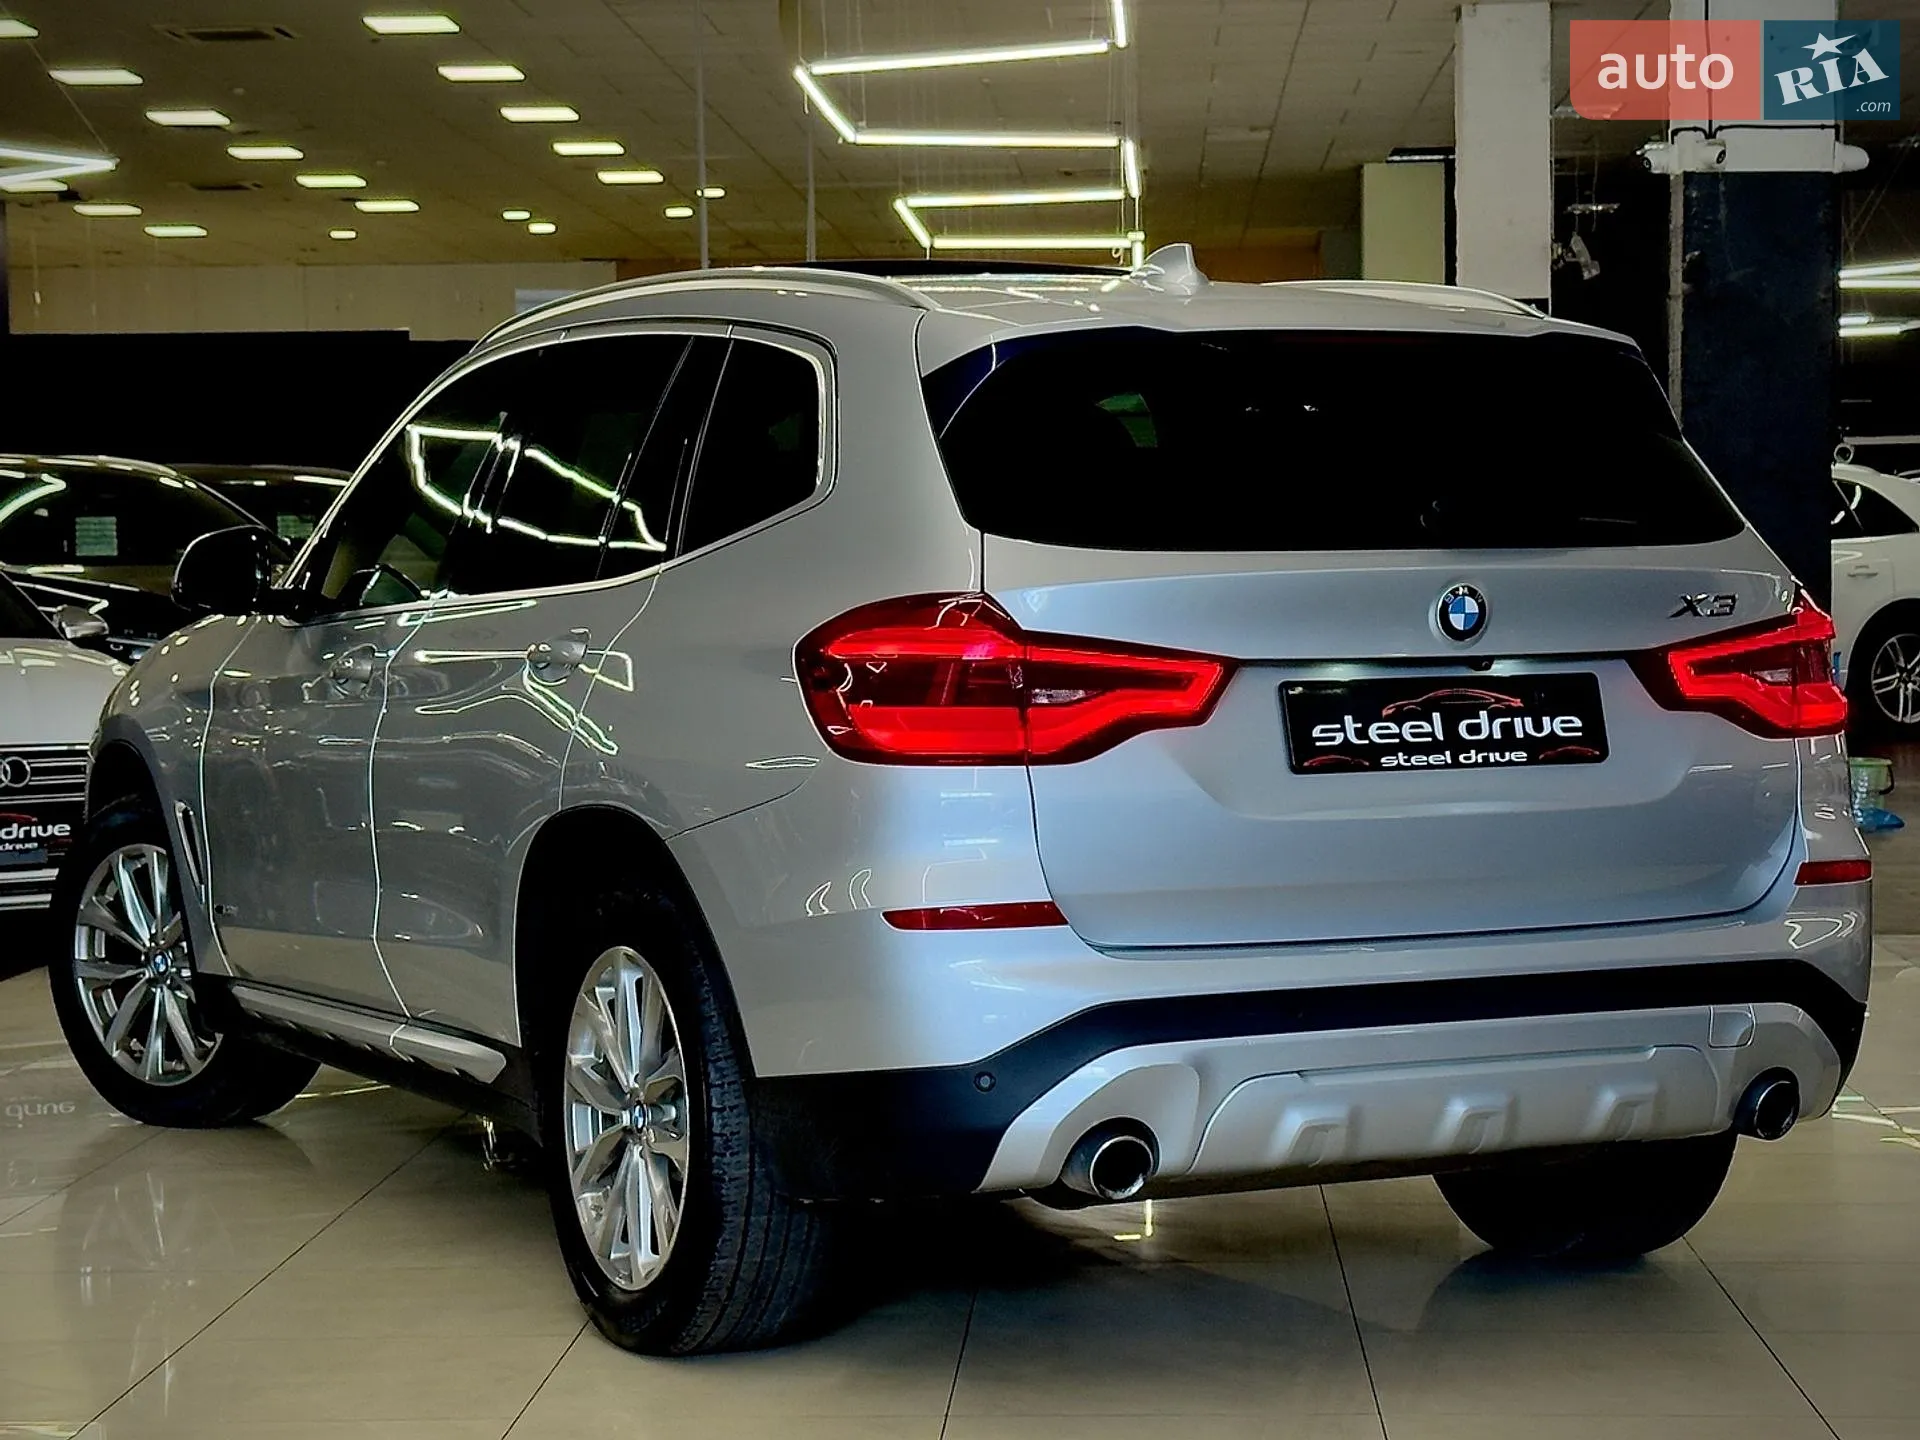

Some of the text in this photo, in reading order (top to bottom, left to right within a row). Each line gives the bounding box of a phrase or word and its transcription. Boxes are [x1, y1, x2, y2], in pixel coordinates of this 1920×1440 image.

[1668, 592, 1739, 619] X3
[1311, 710, 1583, 746] steel drive
[1380, 749, 1528, 767] steel drive
[1, 823, 72, 840] drive
